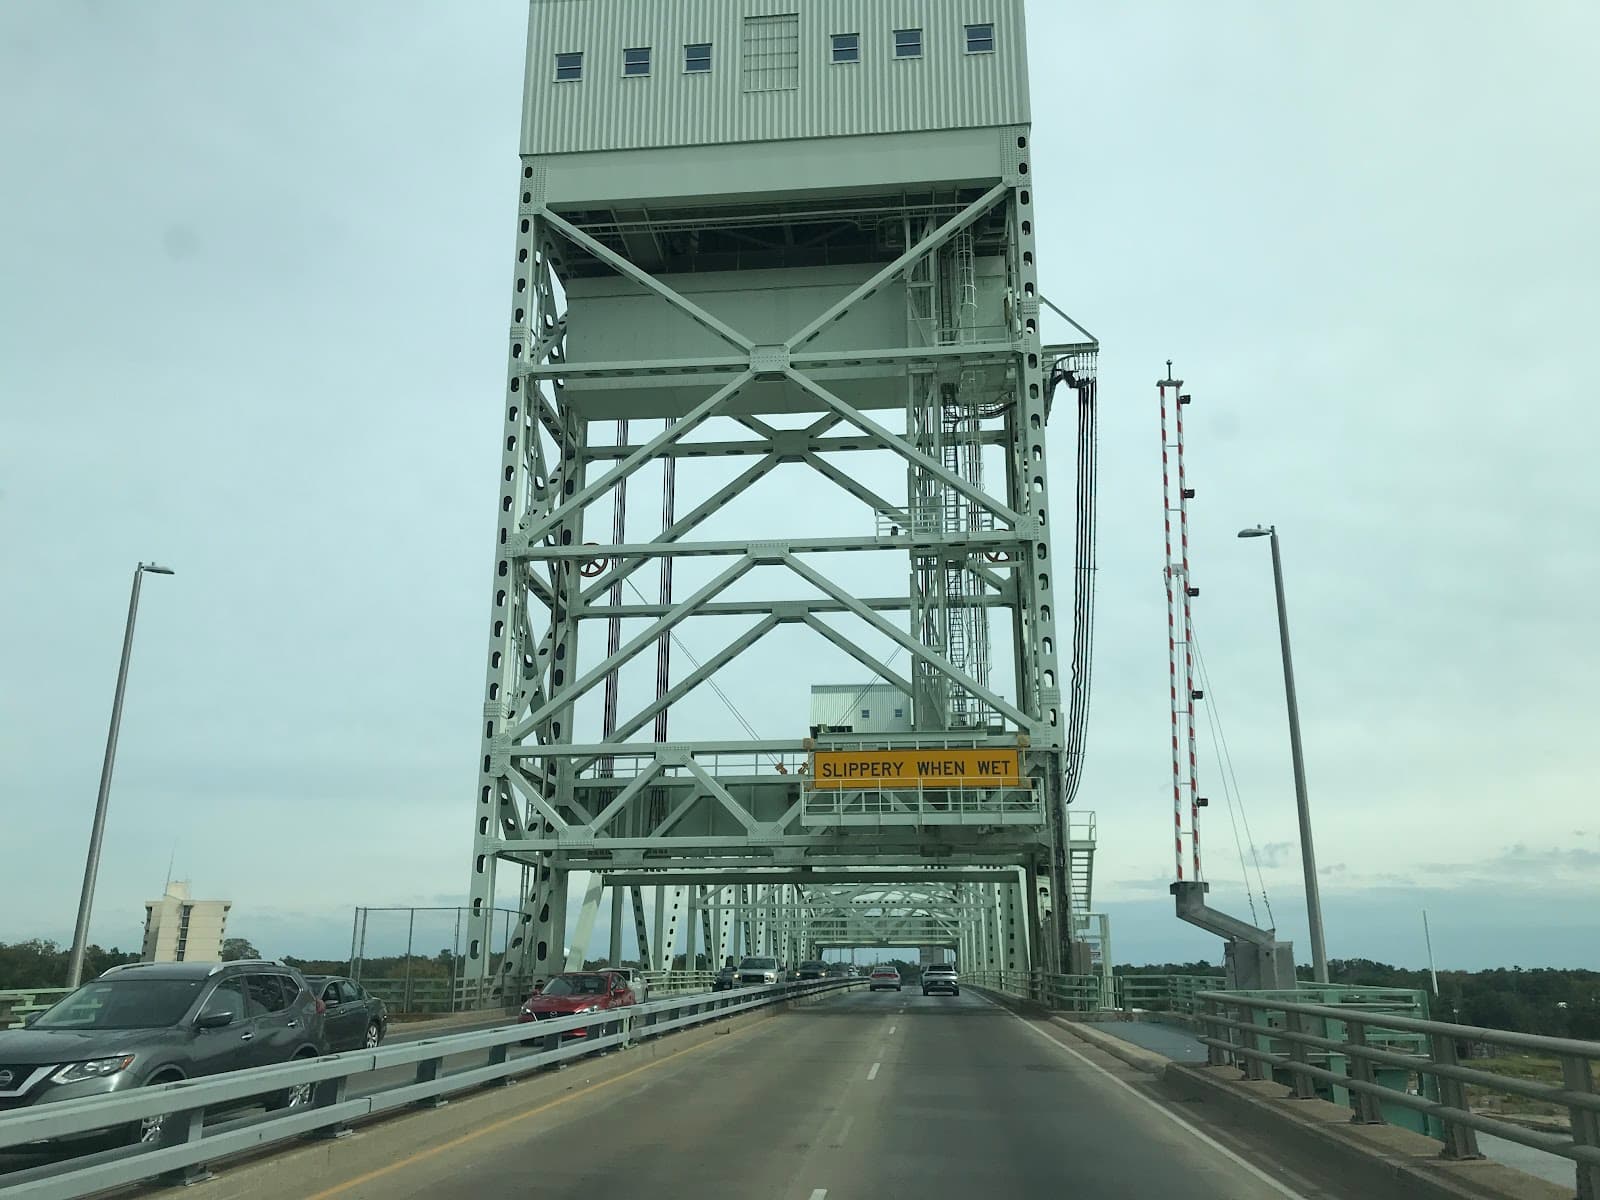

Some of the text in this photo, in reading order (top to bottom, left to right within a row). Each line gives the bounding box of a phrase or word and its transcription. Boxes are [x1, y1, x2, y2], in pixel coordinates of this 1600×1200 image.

[822, 760, 1011, 778] SLIPPERY WHEN WET
